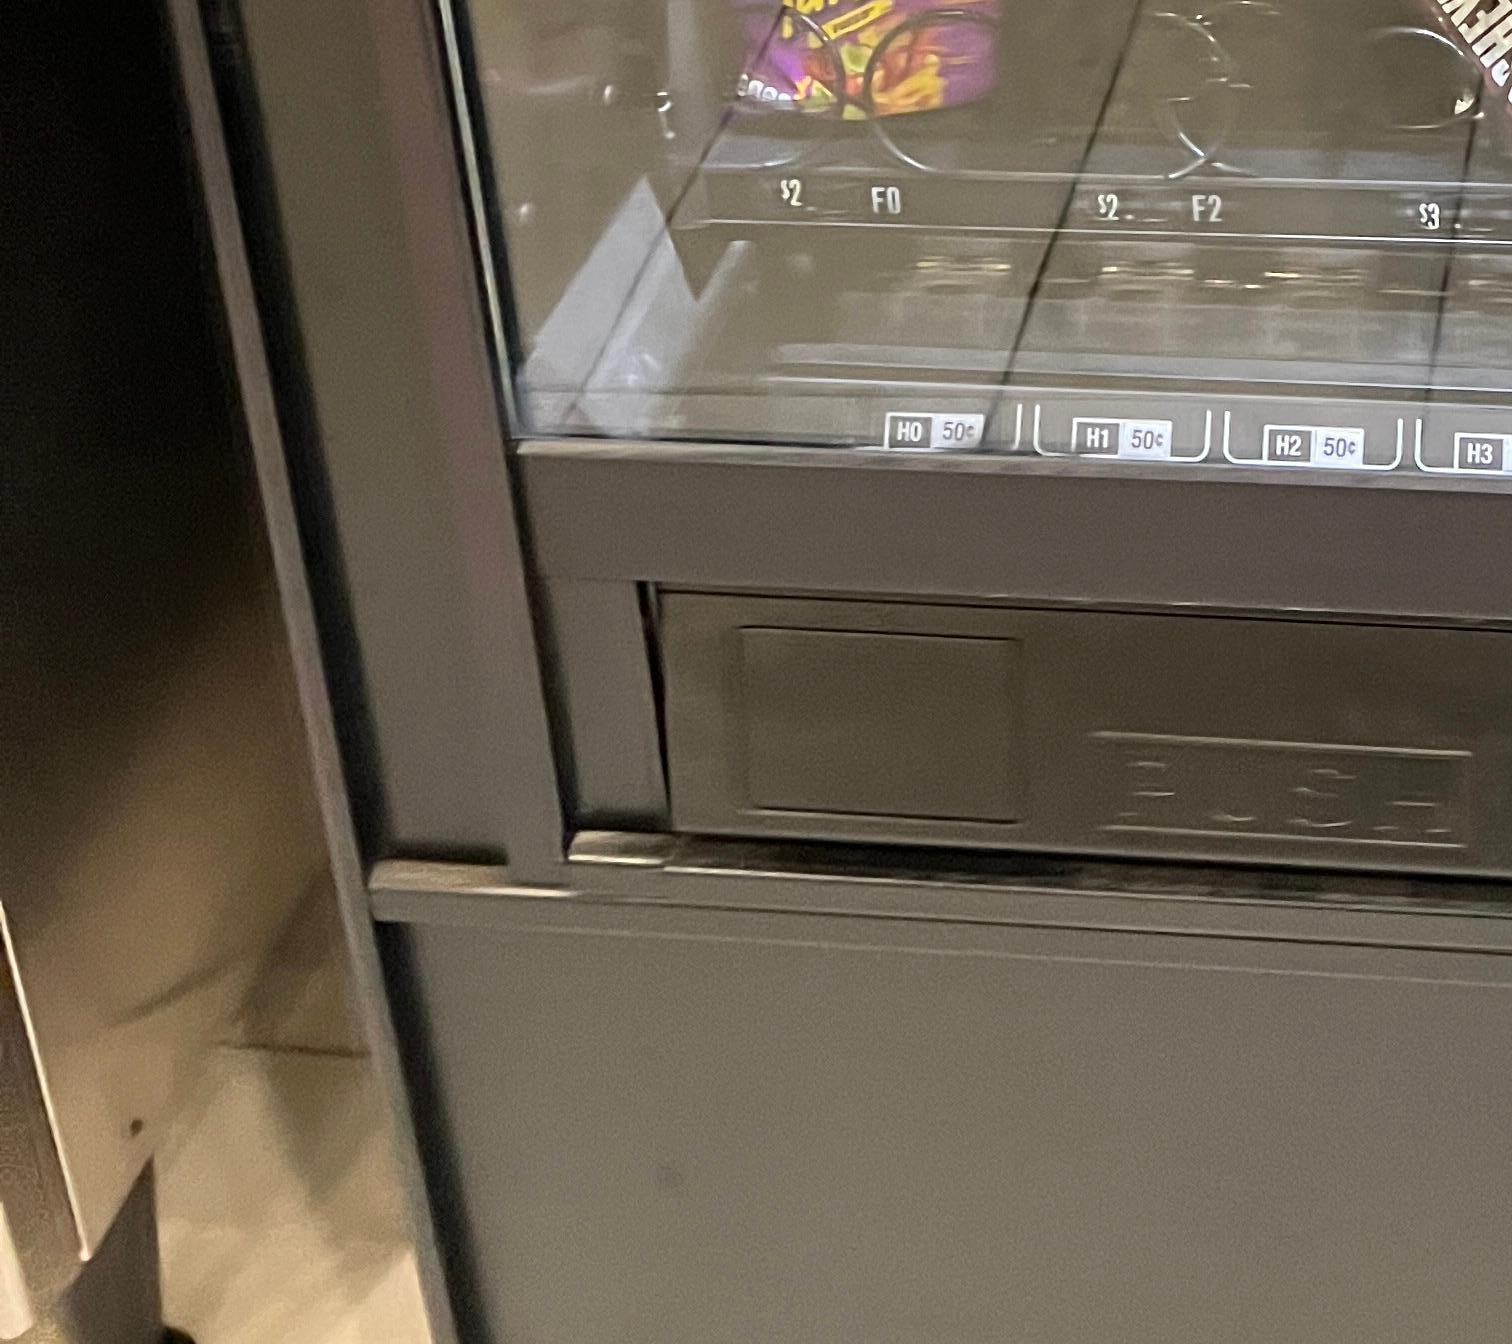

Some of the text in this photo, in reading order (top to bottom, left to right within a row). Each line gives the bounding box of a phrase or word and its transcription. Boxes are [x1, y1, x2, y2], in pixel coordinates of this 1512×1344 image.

[871, 186, 902, 214] F0
[1191, 194, 1222, 222] F2
[896, 421, 923, 442] H0
[1086, 426, 1111, 449] H1
[1274, 434, 1302, 457] H2
[1465, 442, 1493, 465] H3
